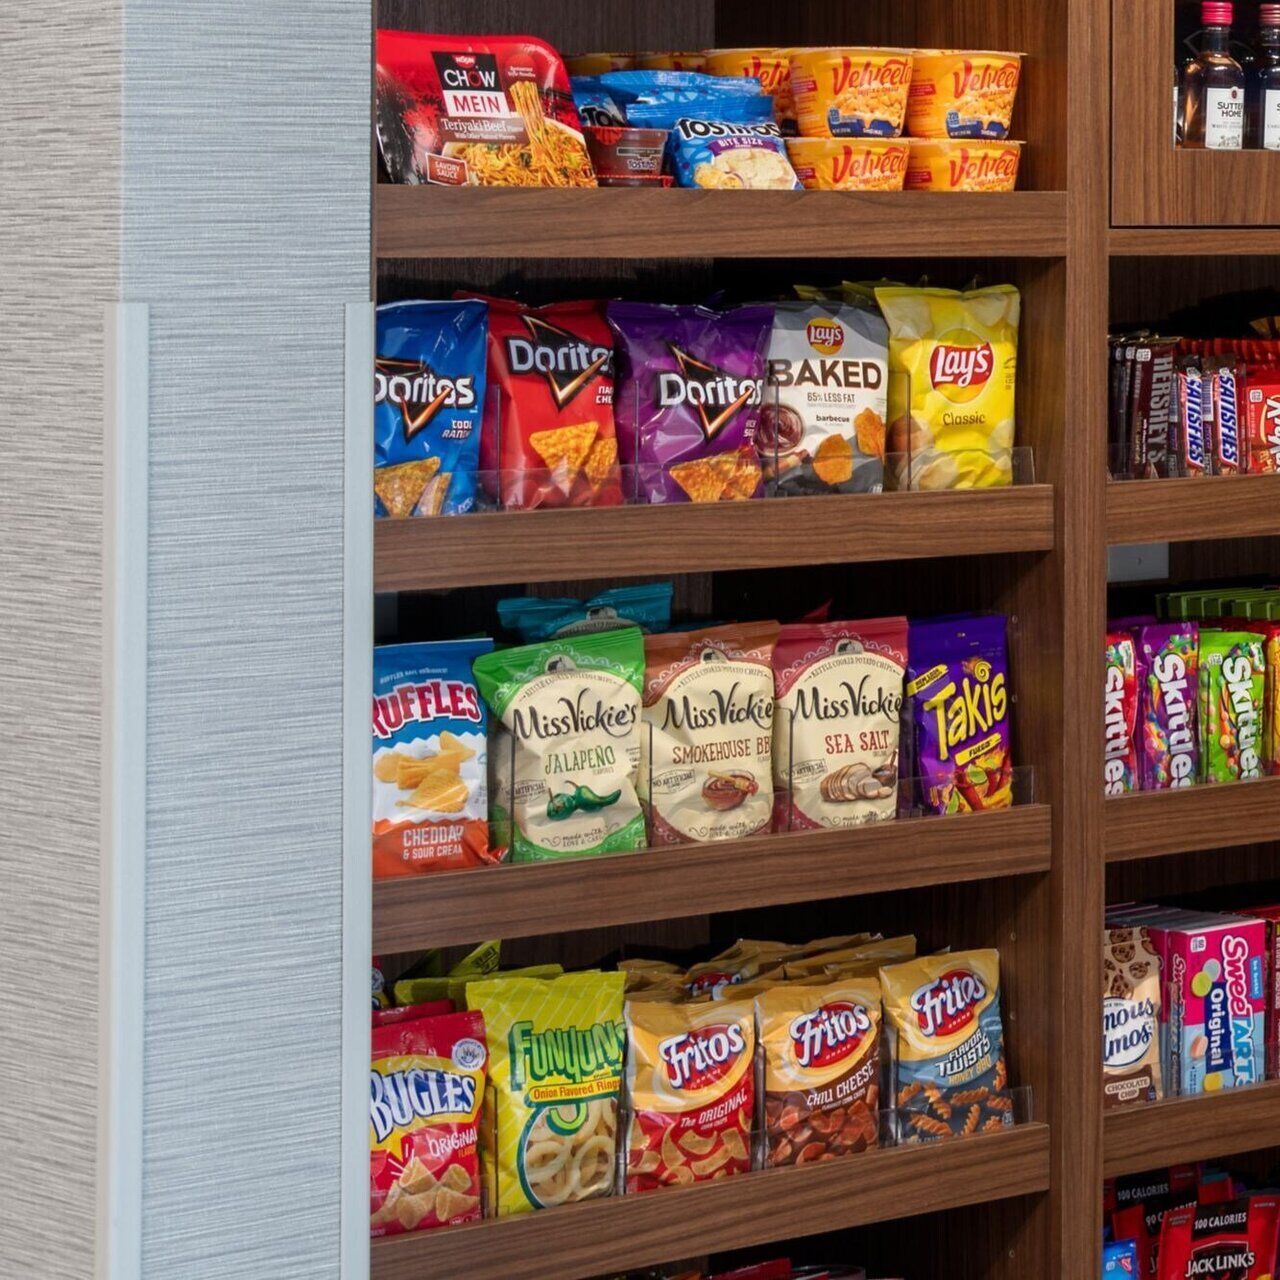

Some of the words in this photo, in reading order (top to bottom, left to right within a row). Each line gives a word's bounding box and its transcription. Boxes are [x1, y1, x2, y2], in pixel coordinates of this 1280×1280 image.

[443, 69, 495, 88] CHOW
[452, 95, 500, 113] MEIN
[1217, 102, 1243, 110] SUTTE
[441, 118, 482, 133] Teriyaki
[483, 120, 506, 131] Beef
[677, 118, 783, 140] TOSTITOS
[810, 325, 841, 347] Lay's
[508, 339, 613, 373] Dorito
[935, 344, 991, 388] Lay's
[374, 374, 475, 405] Doritos
[659, 373, 763, 407] Doritos
[768, 359, 882, 390] BAKED
[824, 393, 842, 403] LESS
[843, 393, 856, 403] FAT
[1147, 356, 1173, 463] HERSHEY'S
[816, 415, 850, 423] barbecue
[942, 411, 987, 426] Classic
[1219, 374, 1238, 464] SATISFIES
[372, 682, 481, 738] RUFFLES
[514, 706, 570, 740] Miss
[557, 687, 637, 737] Vickie's
[661, 695, 716, 731] Miss
[709, 681, 774, 730] Vickie
[791, 687, 848, 720] Miss
[839, 674, 901, 723] Vickie
[923, 673, 1007, 761] Takis
[1105, 666, 1129, 796] Skittles
[1154, 654, 1193, 788] Skittles
[1223, 657, 1260, 779] Skittles
[673, 738, 751, 765] SMOKEHOUSE
[757, 736, 771, 755] BB
[825, 733, 854, 754] SEA
[860, 730, 889, 751] SALT
[545, 745, 616, 775] JALAPEÑO
[403, 849, 410, 859] &
[413, 847, 434, 858] SOUR
[911, 974, 986, 1037] Fritos
[790, 1004, 870, 1066] Fritos
[1207, 987, 1224, 1065] original
[659, 1022, 745, 1088] Fritos
[935, 1037, 991, 1077] TWISTS
[949, 1029, 982, 1061] FLAVOR
[1104, 1024, 1151, 1062] mos
[533, 1086, 557, 1100] Onion
[559, 1084, 594, 1099] Flavored
[807, 1088, 834, 1106] CHILI
[836, 1064, 874, 1099] CHEESE
[1106, 1078, 1149, 1093] CHOCOLATE
[1119, 1090, 1138, 1099] CHIP
[370, 1069, 475, 1142] BUGLES
[681, 1117, 696, 1128] The
[699, 1091, 748, 1123] ORIGINAL
[1117, 1189, 1130, 1201] 100
[1131, 1184, 1169, 1199] CALORIES
[1194, 1218, 1208, 1230] 100
[1209, 1212, 1247, 1227] CALORIES
[1185, 1255, 1216, 1278] JACK
[1216, 1252, 1255, 1271] LINK'S
